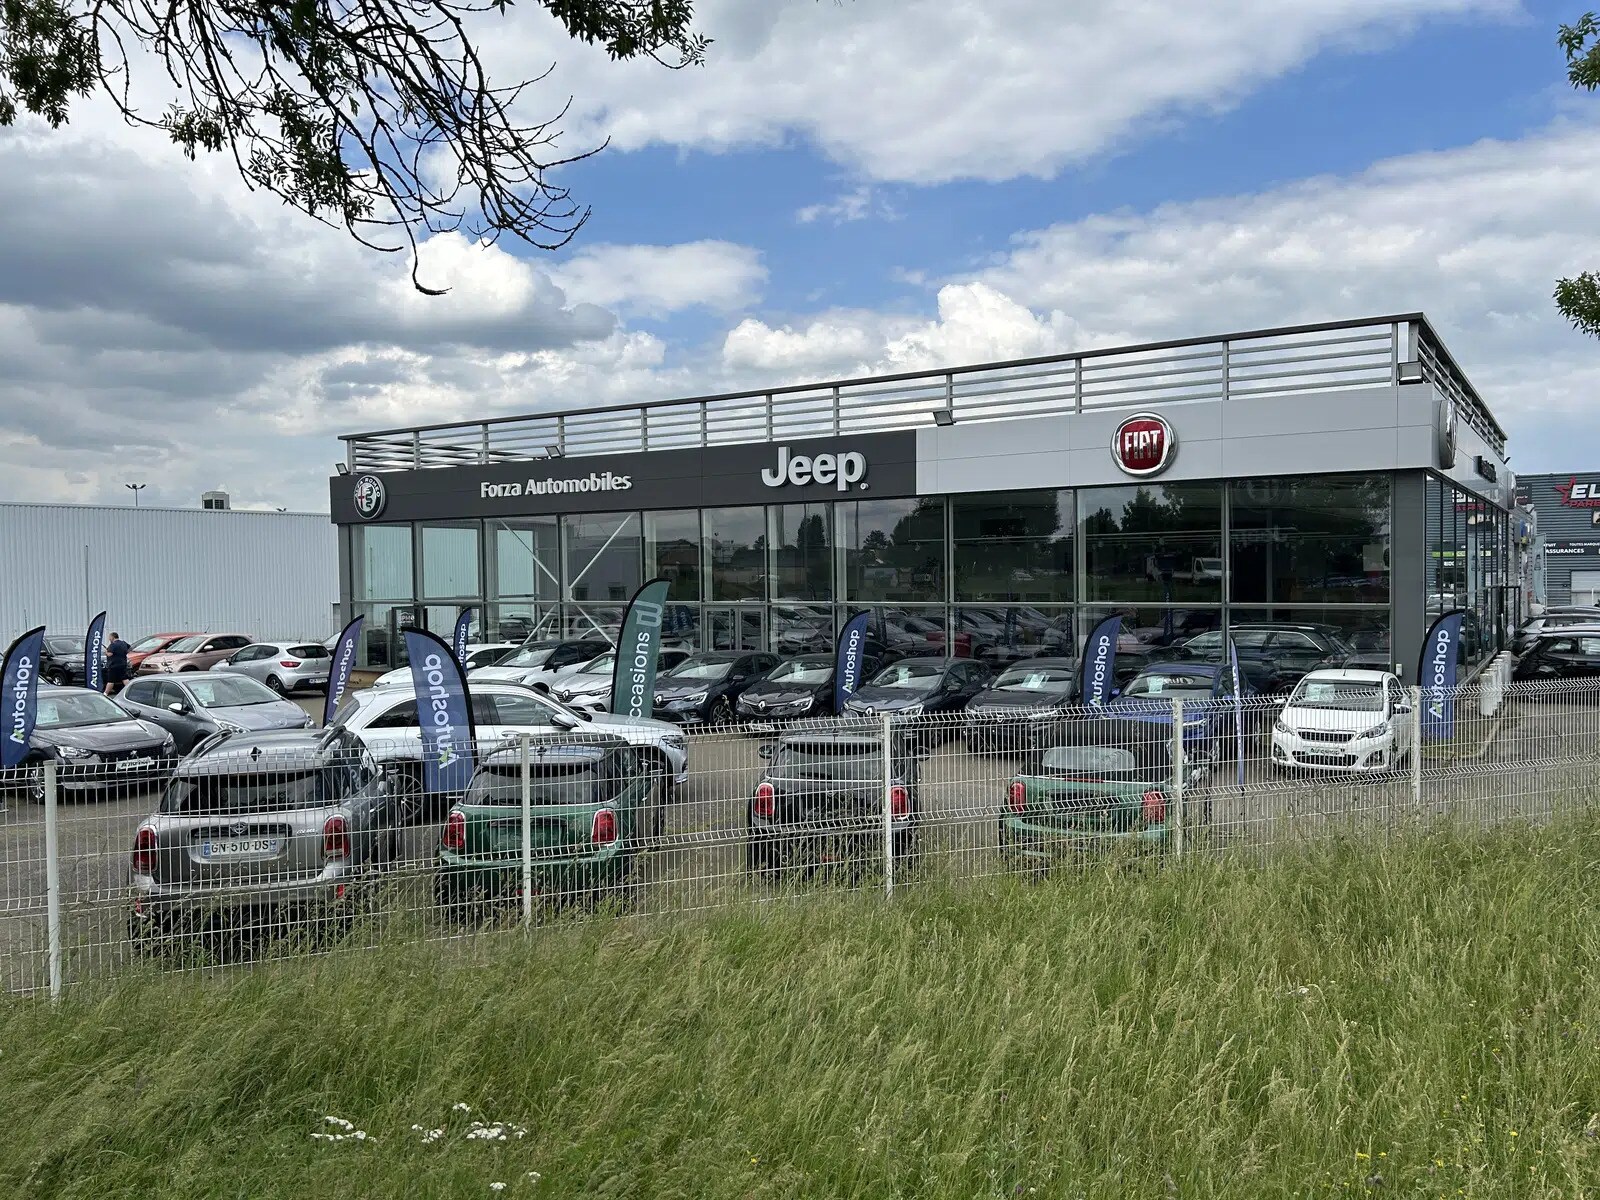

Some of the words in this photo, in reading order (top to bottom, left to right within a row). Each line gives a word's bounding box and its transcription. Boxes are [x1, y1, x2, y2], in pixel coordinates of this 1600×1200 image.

[761, 446, 866, 492] Jeep
[1124, 429, 1161, 460] FIAT
[480, 481, 522, 498] Forza
[525, 471, 632, 497] Automobiles
[90, 630, 101, 688] Autoshop
[629, 631, 650, 720] ccasions
[842, 629, 861, 694] Autoshop
[1089, 635, 1111, 709] Autoshop
[1428, 629, 1451, 719] Autoshop
[9, 656, 33, 745] Autoshop
